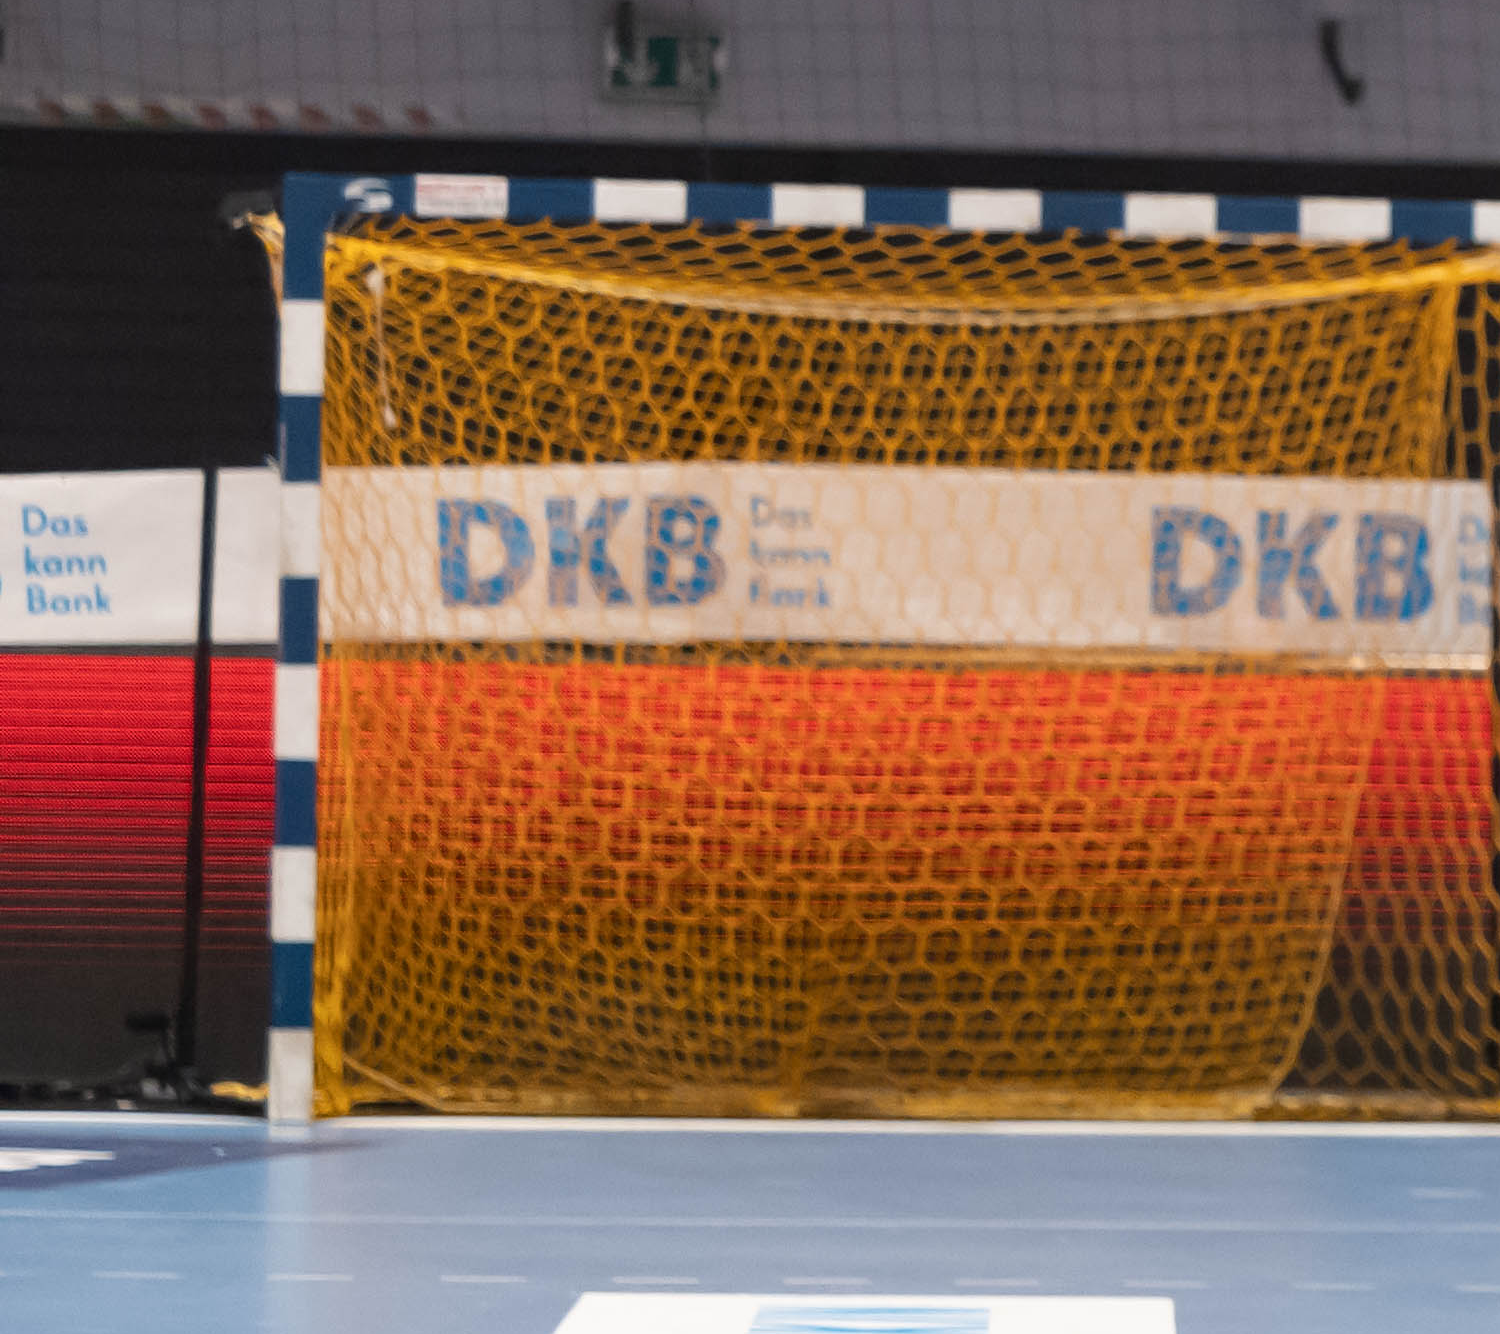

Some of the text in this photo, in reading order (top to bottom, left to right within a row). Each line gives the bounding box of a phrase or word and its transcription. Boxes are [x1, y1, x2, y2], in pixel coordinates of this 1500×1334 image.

[20, 504, 90, 539] Das
[22, 546, 109, 577] kann
[436, 494, 727, 609] DKB
[1149, 505, 1436, 622] DKB
[25, 583, 113, 617] Bank
